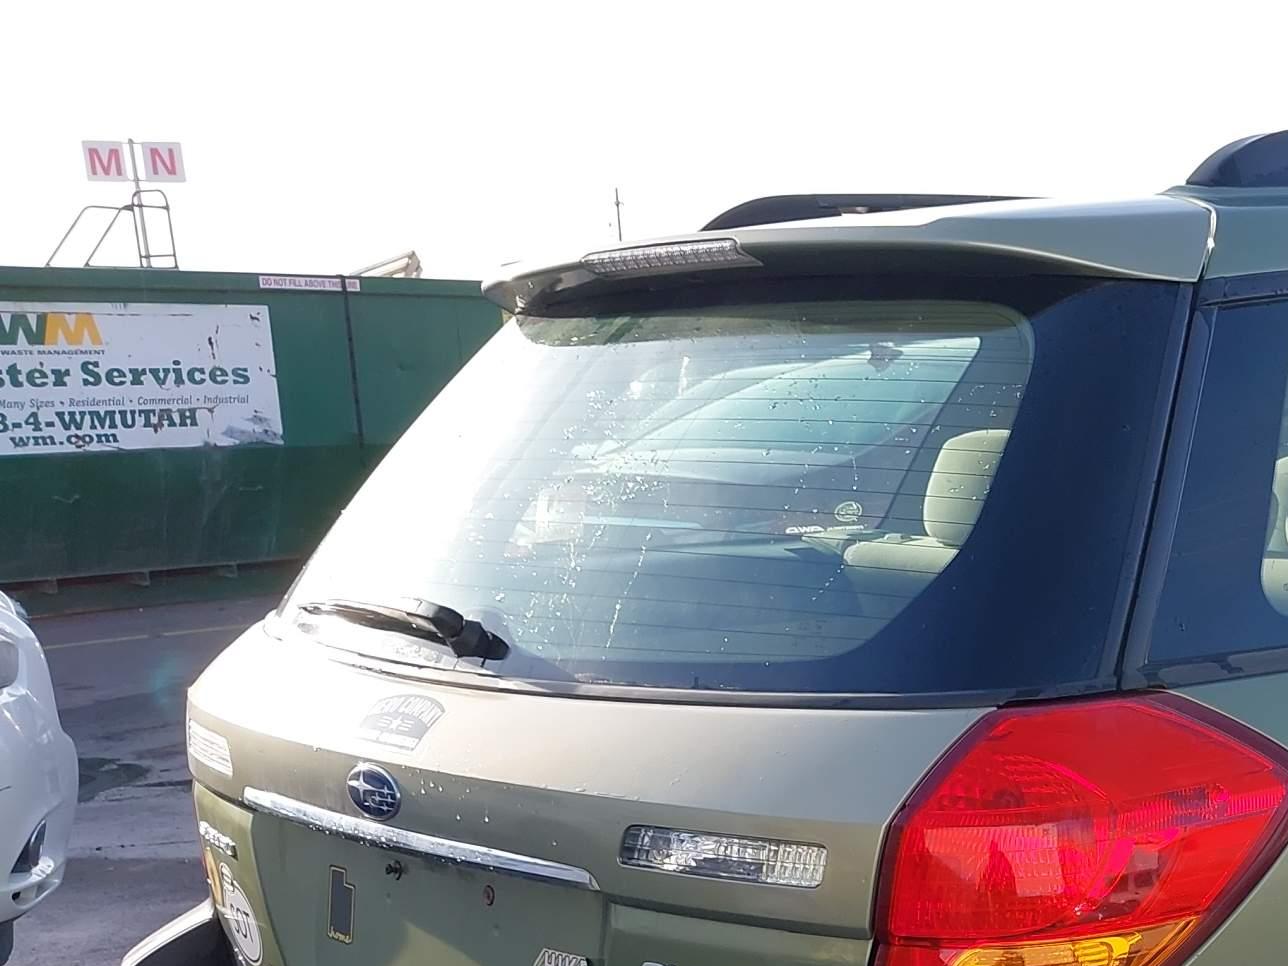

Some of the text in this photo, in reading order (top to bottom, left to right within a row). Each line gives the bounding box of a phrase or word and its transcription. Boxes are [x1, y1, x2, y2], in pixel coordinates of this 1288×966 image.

[87, 147, 123, 176] M
[150, 147, 177, 175] N
[262, 278, 273, 286] DO
[273, 278, 287, 287] NOT
[288, 279, 303, 288] FILL
[0, 360, 250, 388] ter Services
[29, 398, 55, 408] Sizes
[68, 396, 125, 408] Residential
[137, 395, 192, 406] Commercial
[203, 394, 249, 405] Industrial
[9, 433, 120, 447] wm.com
